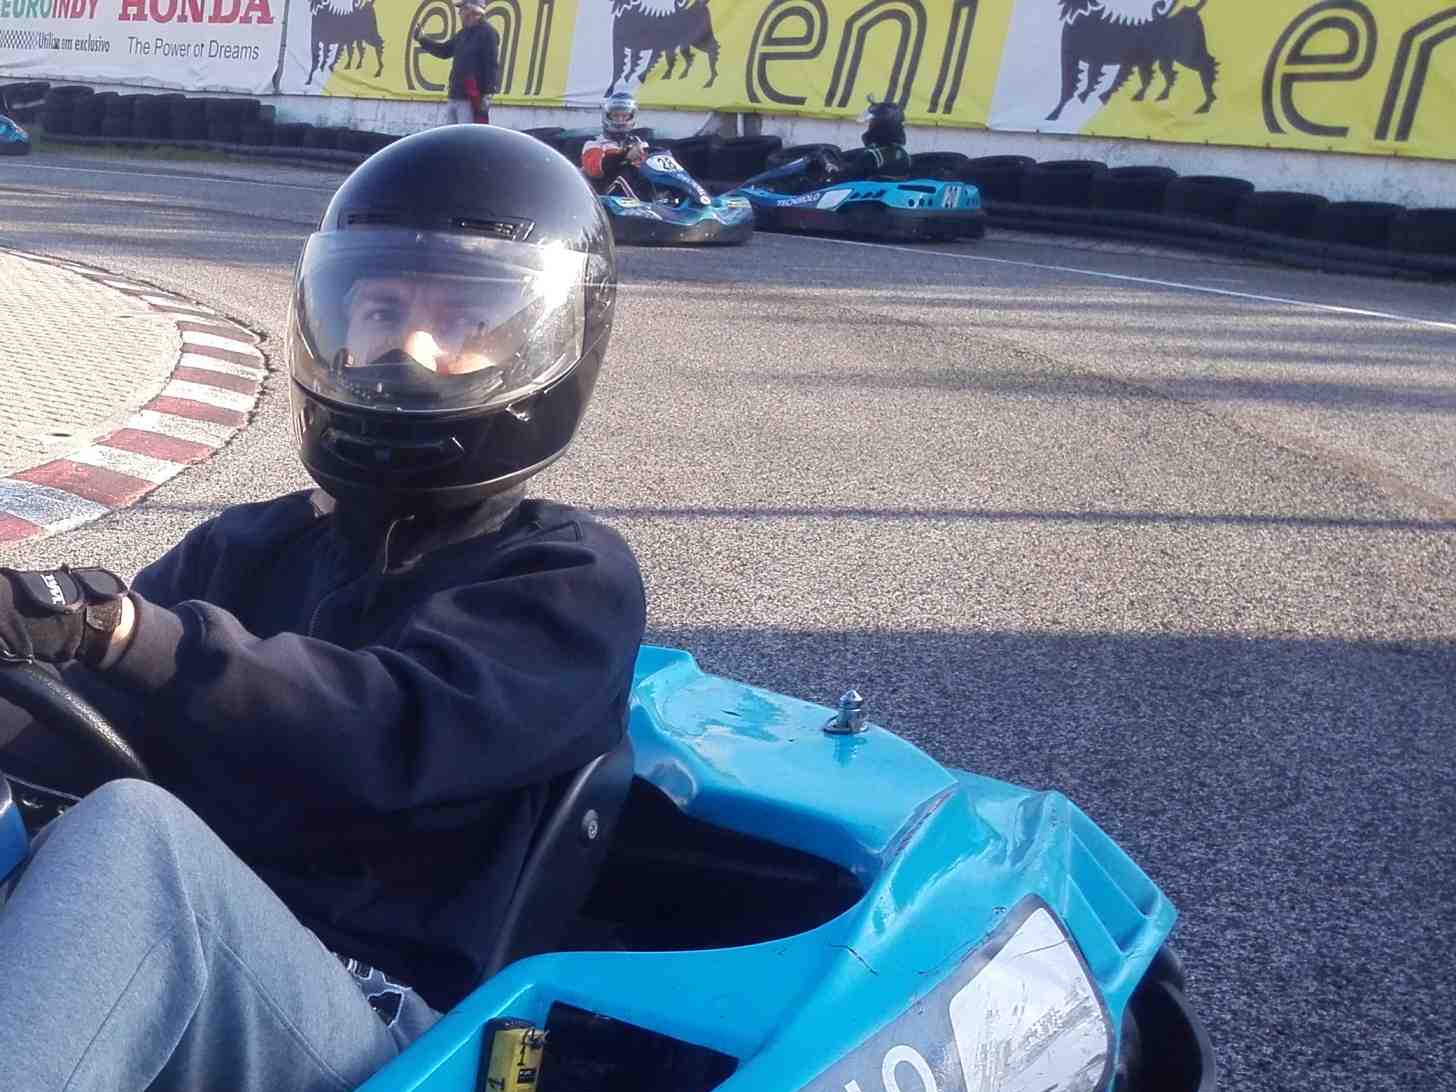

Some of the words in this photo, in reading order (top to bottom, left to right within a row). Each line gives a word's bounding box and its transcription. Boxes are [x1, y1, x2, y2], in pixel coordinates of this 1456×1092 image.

[118, 0, 273, 24] HONDA
[128, 36, 151, 55] The
[154, 37, 192, 57] Power
[208, 39, 260, 61] Dreams
[745, 0, 968, 114] eni
